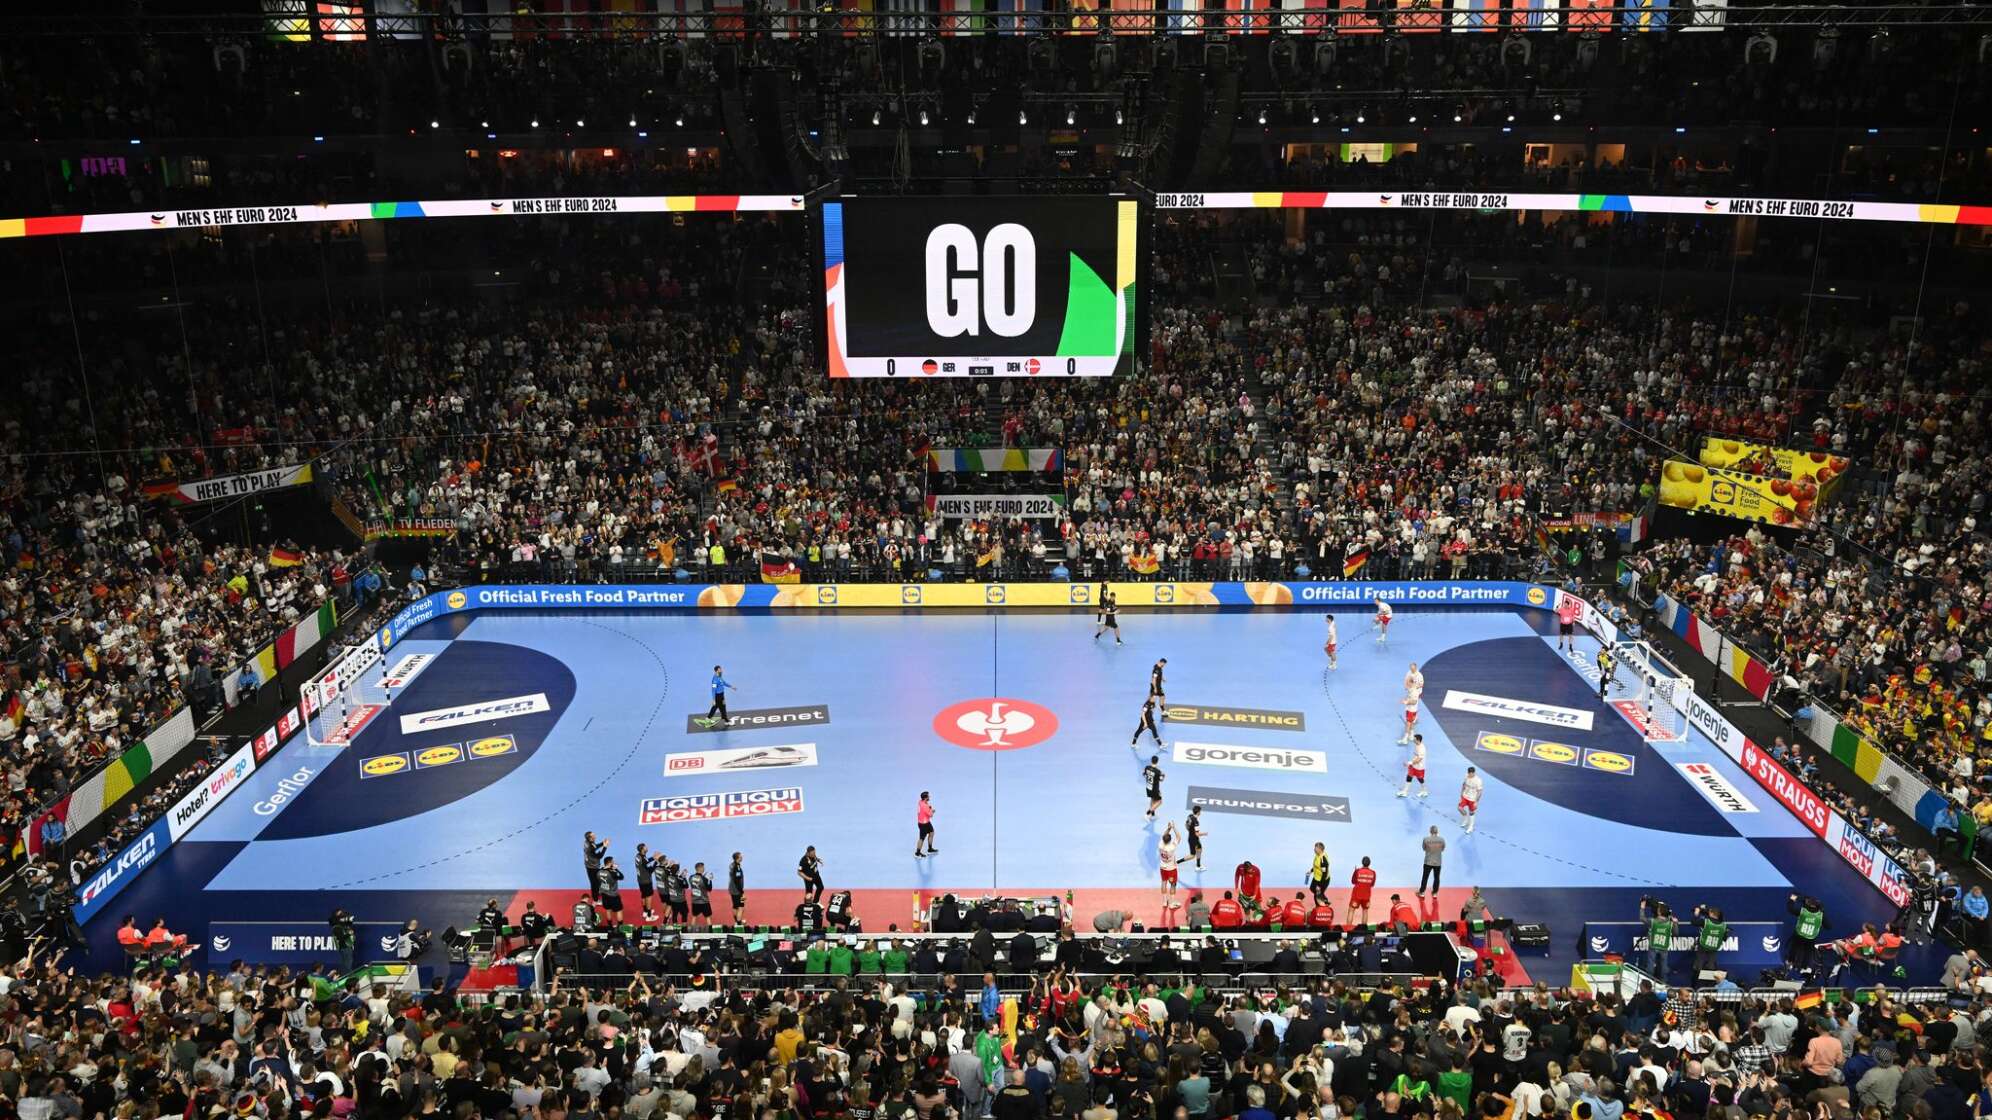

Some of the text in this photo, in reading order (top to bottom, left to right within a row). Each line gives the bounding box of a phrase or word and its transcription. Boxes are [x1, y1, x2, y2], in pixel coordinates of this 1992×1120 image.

[545, 199, 562, 212] EHF
[565, 199, 589, 212] EURO
[592, 198, 617, 211] 2024
[1180, 194, 1205, 207] 2024
[1432, 194, 1451, 207] EHF
[1453, 194, 1478, 207] EURO
[1481, 195, 1508, 208] 2024
[1766, 200, 1787, 215] EHF
[1789, 201, 1819, 216] EURO
[1822, 202, 1854, 217] 2024
[213, 209, 233, 224] EHF
[236, 208, 265, 222] EURO
[268, 207, 297, 221] 2024
[925, 223, 1036, 338] GO
[886, 358, 896, 376] 0
[942, 362, 956, 373] GER
[1006, 362, 1021, 373] DEN
[1066, 357, 1076, 375] 0
[196, 471, 281, 500] HERE TO PLAY
[938, 500, 971, 514] MEN'S
[1025, 500, 1054, 514] 2024
[415, 518, 457, 529] FLIEDEN
[479, 590, 685, 603] Official Fresh Food Partner
[1302, 587, 1509, 600] Official Fresh Food Partner
[412, 598, 433, 614] Fresh
[408, 610, 433, 627] Partner
[419, 701, 534, 724] FALKEN
[1461, 698, 1579, 721] FALKEN
[727, 710, 824, 726] freenet
[1203, 711, 1298, 725] HARTING
[673, 758, 702, 769] DB
[1185, 747, 1314, 767] gorenje
[176, 757, 247, 826] Hotel? trivago
[253, 766, 314, 817] Gerflor
[729, 789, 797, 804] LIQUI
[1699, 773, 1747, 813] WÜRTH
[1759, 758, 1825, 829] STRAUSS
[648, 795, 717, 811] LIQUI
[728, 800, 800, 816] MOLY
[1191, 797, 1318, 814] GRUNDFOS
[644, 807, 720, 822] MOLY
[1844, 824, 1875, 859] LIQUI
[137, 848, 156, 870] TYRES
[1841, 843, 1872, 876] MOLY
[82, 832, 155, 906] FALKEN
[1801, 924, 1815, 935] RH
[271, 936, 338, 951] HERE TO PLA
[1654, 934, 1667, 946] RH
[1705, 935, 1719, 948] RH
